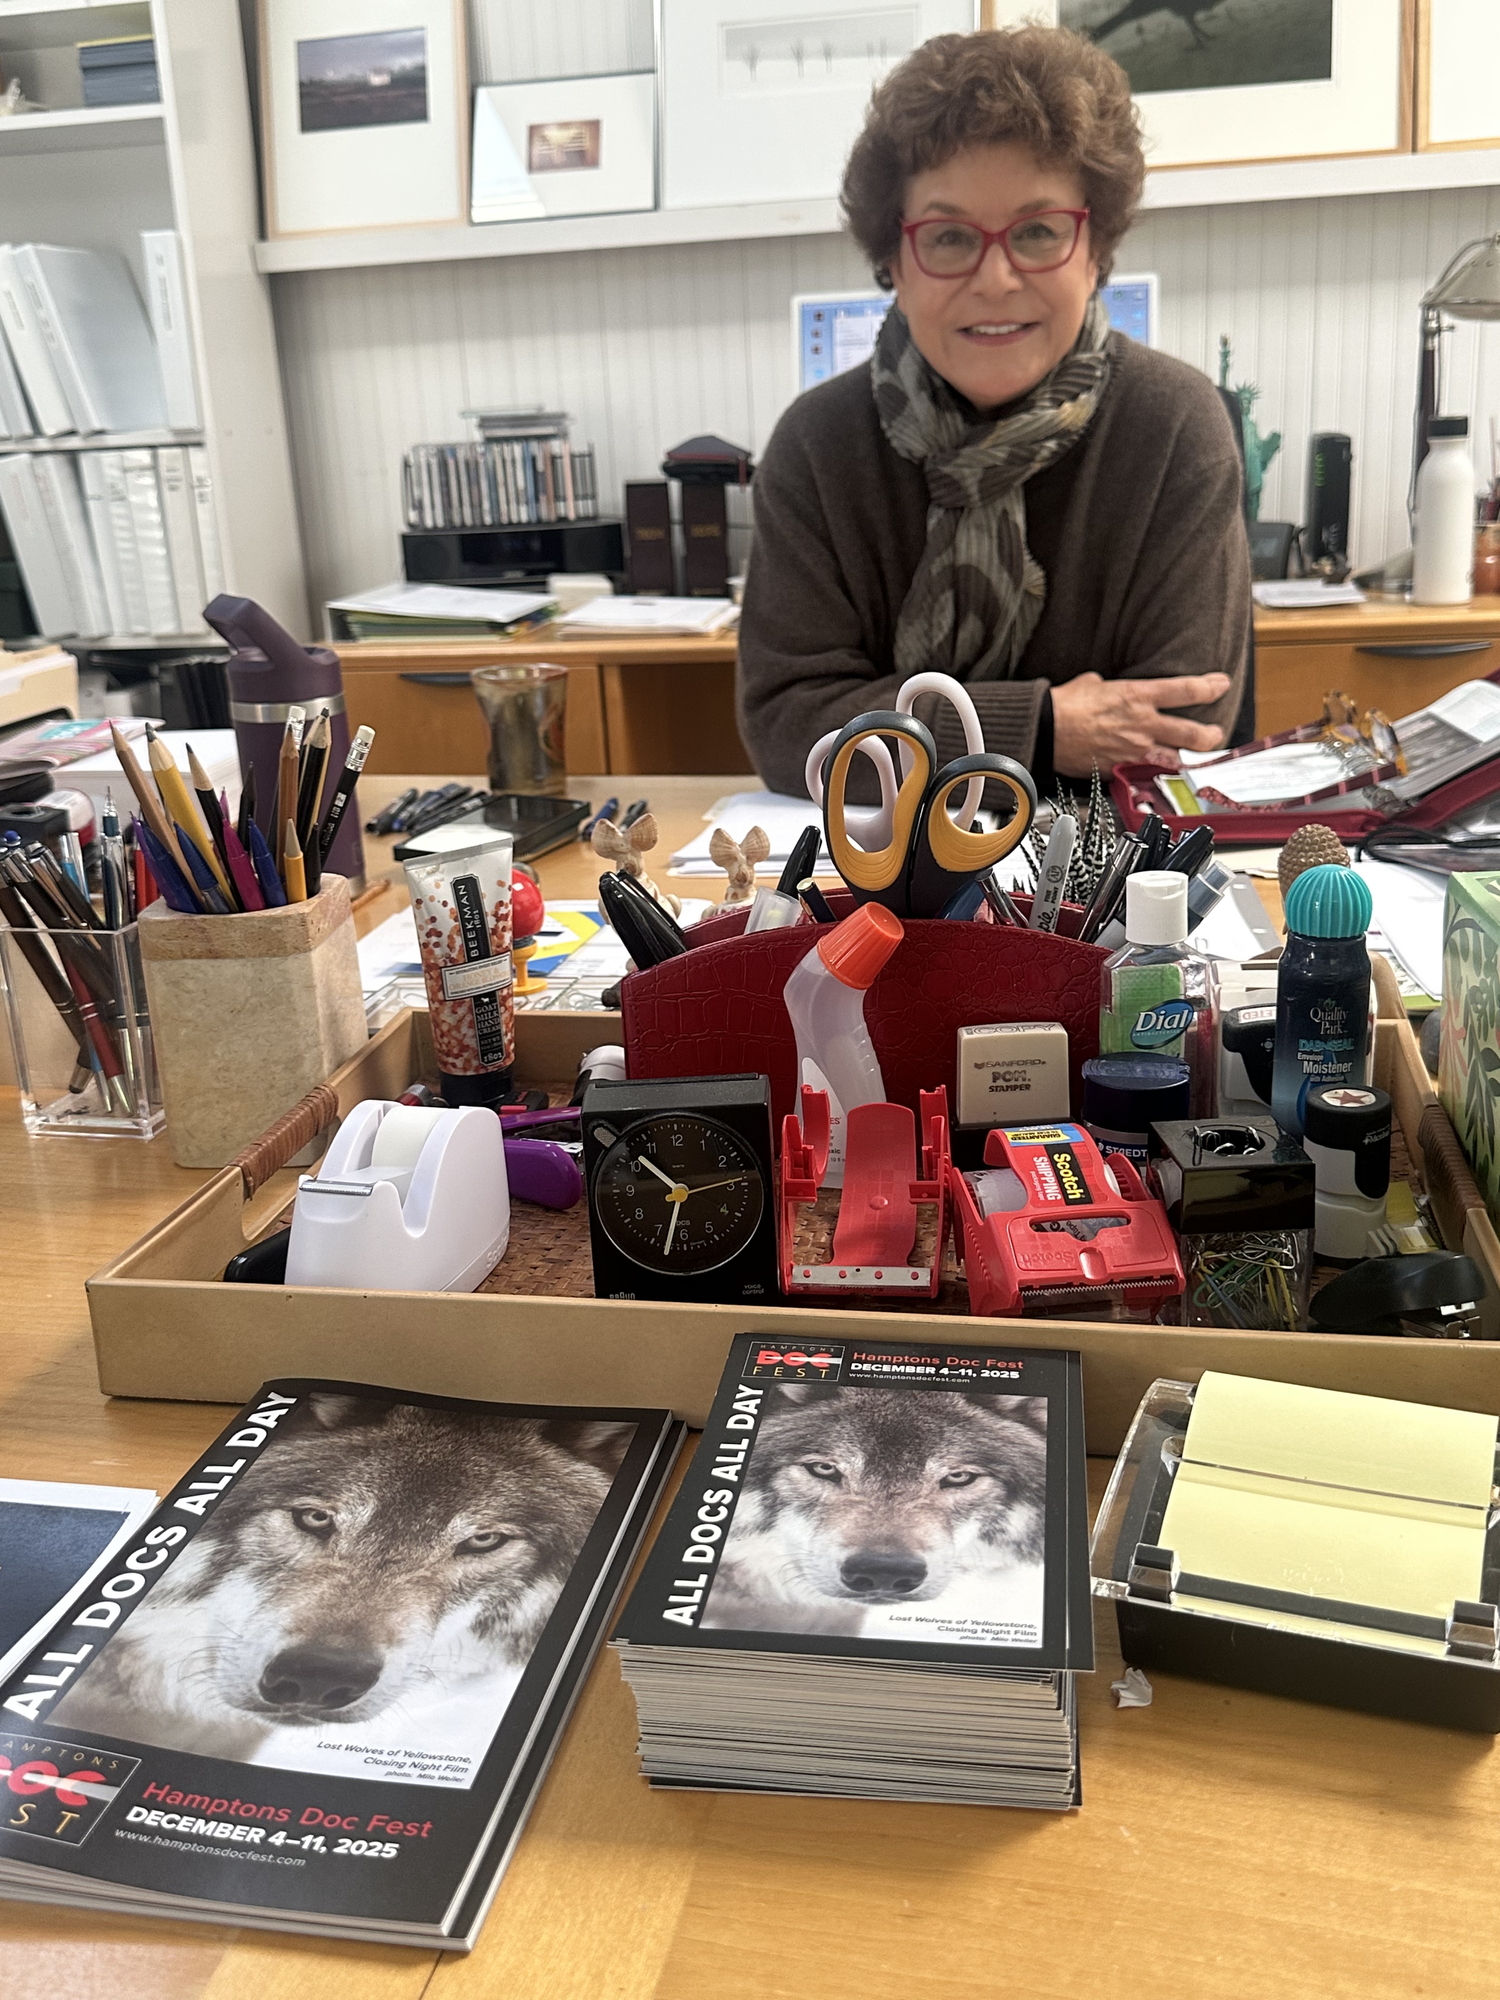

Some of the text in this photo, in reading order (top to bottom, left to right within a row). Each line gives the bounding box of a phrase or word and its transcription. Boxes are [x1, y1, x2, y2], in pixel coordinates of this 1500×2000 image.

[1051, 887, 1059, 904] POINT
[457, 884, 480, 958] BEEKMAN
[474, 909, 482, 929] 1801
[476, 1003, 498, 1013] GOAT
[1310, 1006, 1349, 1023] Quality
[477, 1011, 499, 1021] MILK
[1135, 1009, 1189, 1032] Dial
[478, 1018, 500, 1028] HAND
[1320, 1021, 1343, 1035] Park
[484, 1052, 502, 1062] 1801
[985, 1059, 1041, 1068] SANFORD
[1303, 1061, 1353, 1074] Moistener
[989, 1084, 1031, 1093] STAMPER
[671, 1134, 684, 1147] 12
[1011, 1133, 1061, 1141] GUARANTEED
[646, 1142, 657, 1154] 11
[700, 1139, 706, 1151] 1
[1105, 1145, 1148, 1158] STAEDT
[629, 1161, 641, 1173] 10
[718, 1155, 727, 1168] 2
[1033, 1156, 1062, 1200] SHIPPING
[1053, 1153, 1084, 1199] Scotch
[626, 1184, 635, 1197] 9
[726, 1179, 735, 1191] 3
[635, 1208, 644, 1220] 8
[720, 1203, 729, 1216] 4
[655, 1224, 663, 1236] 7
[705, 1221, 714, 1233] 5
[680, 1229, 689, 1240] 6
[756, 1350, 832, 1368] DOC
[853, 1351, 1024, 1369] Hamptons Doc Fest
[753, 1366, 830, 1379] FEST
[850, 1362, 936, 1375] DECEMBER
[980, 1369, 1020, 1379] 2025
[849, 1372, 971, 1384] www.hamptonsdocfest.com
[662, 1383, 764, 1626] ALL DOCS ALL DAY
[2, 1391, 298, 1721] ALL DOCS ALL DAY
[915, 1616, 953, 1625] Wolves
[955, 1618, 967, 1626] of
[970, 1619, 1038, 1630] Yellowstone,
[937, 1625, 1038, 1637] Closing Night Film
[4, 1740, 119, 1769] AMPTONS
[317, 1741, 472, 1764] Lost Wolves of Yellowstone,
[363, 1756, 469, 1774] Closing Night Film
[385, 1770, 414, 1778] photo:
[0, 1755, 107, 1807] OC
[142, 1781, 433, 1838] Hamptons Doc Fest
[10, 1803, 80, 1834] ST
[126, 1805, 266, 1844] DECEMBER
[333, 1838, 401, 1859] 2025
[114, 1828, 307, 1867] www.hamptonsdocfest.com
